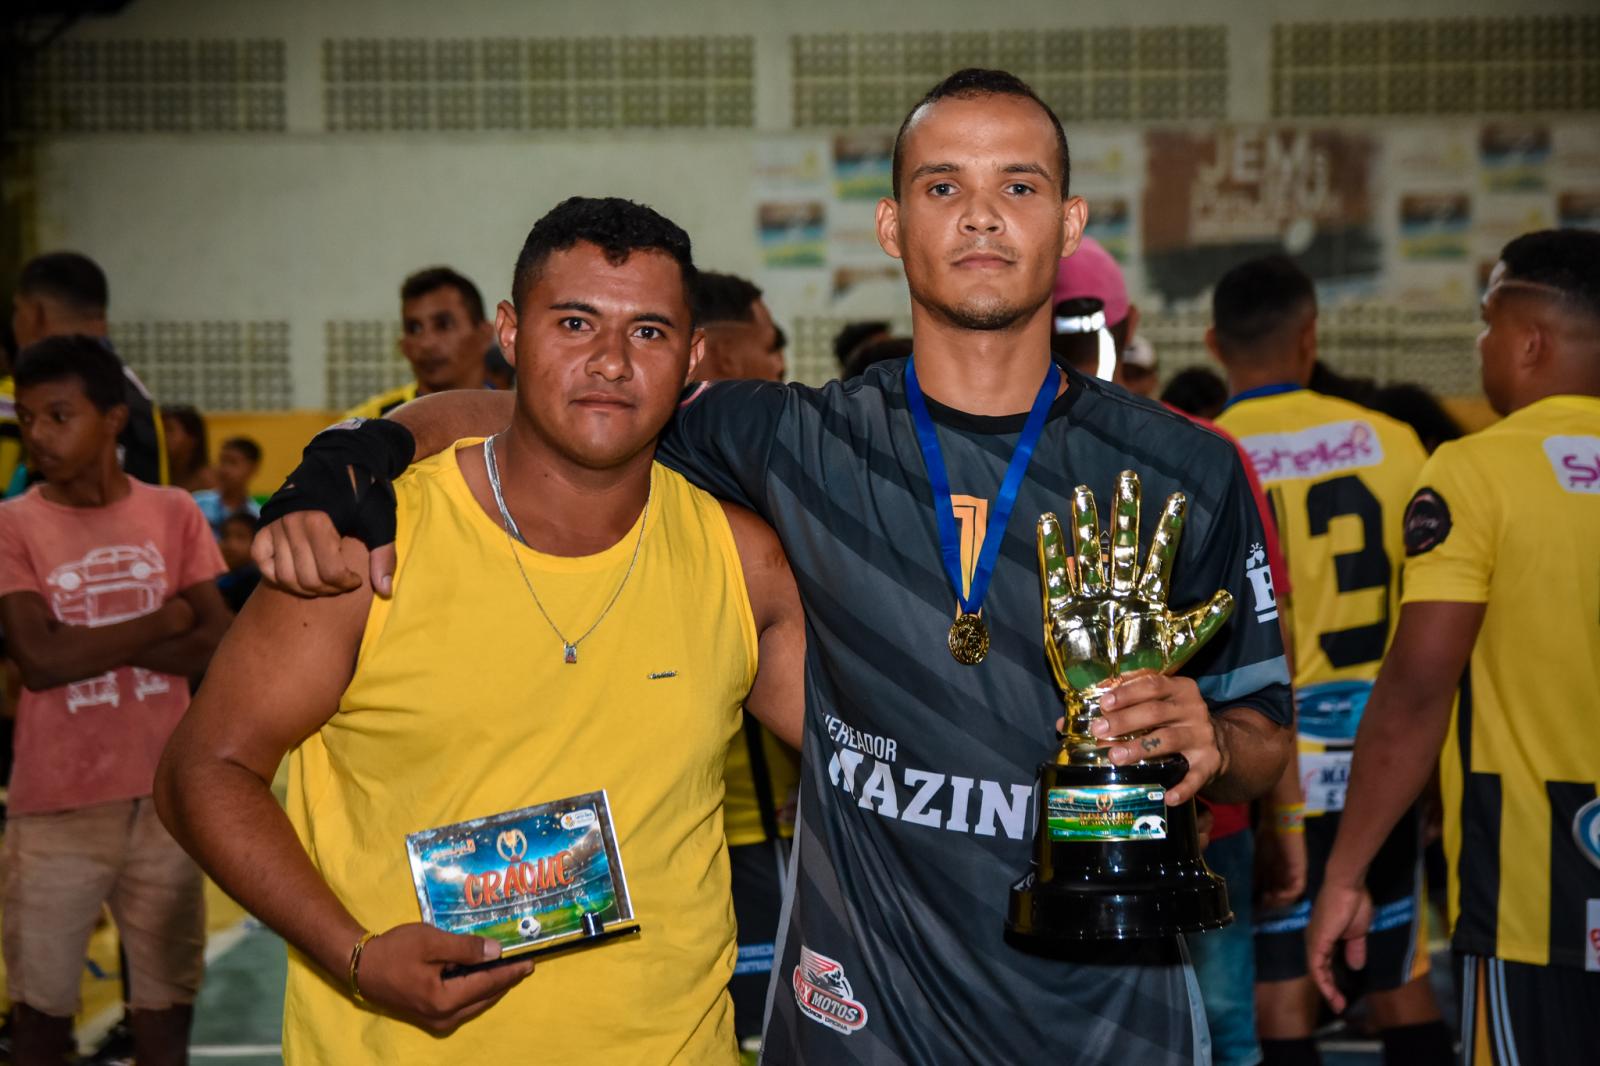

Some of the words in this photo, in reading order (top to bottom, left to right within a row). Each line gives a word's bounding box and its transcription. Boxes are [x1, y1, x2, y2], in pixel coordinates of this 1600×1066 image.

[1307, 476, 1391, 668] 3
[464, 851, 575, 908] CRAQUE
[811, 991, 858, 1021] MOTOS
